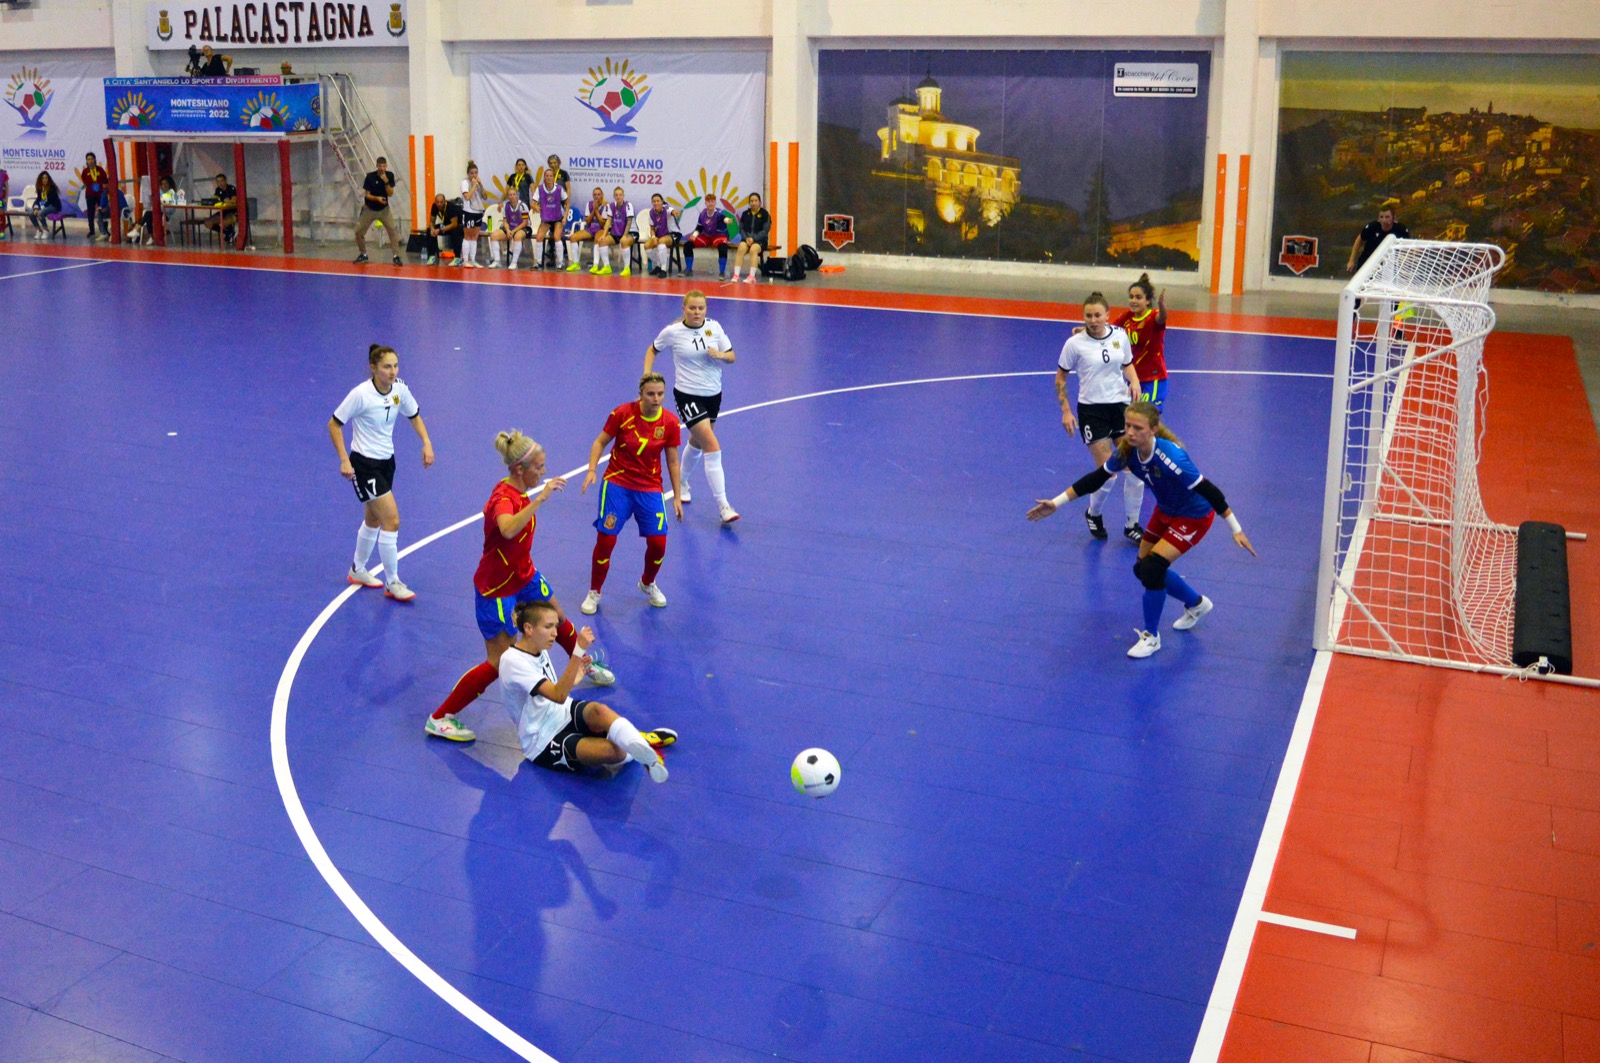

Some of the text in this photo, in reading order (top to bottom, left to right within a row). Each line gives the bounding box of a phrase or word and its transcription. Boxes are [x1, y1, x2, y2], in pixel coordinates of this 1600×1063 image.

[184, 2, 374, 44] PALACASTAGNA
[170, 98, 230, 108] MONTESILVANO
[209, 109, 230, 118] 2022
[2, 148, 66, 158] MONTESILVANO
[44, 161, 66, 171] 2022
[569, 156, 664, 170] MONTESILVANO
[630, 173, 663, 185] 2022
[691, 337, 706, 351] 11
[1101, 349, 1110, 364] 6
[384, 406, 391, 422] 7
[684, 401, 700, 417] 11
[1084, 424, 1093, 441] 6
[636, 437, 649, 456] 7
[367, 478, 377, 496] 7
[655, 512, 665, 531] 7
[539, 578, 550, 597] 6
[550, 740, 561, 756] 17
